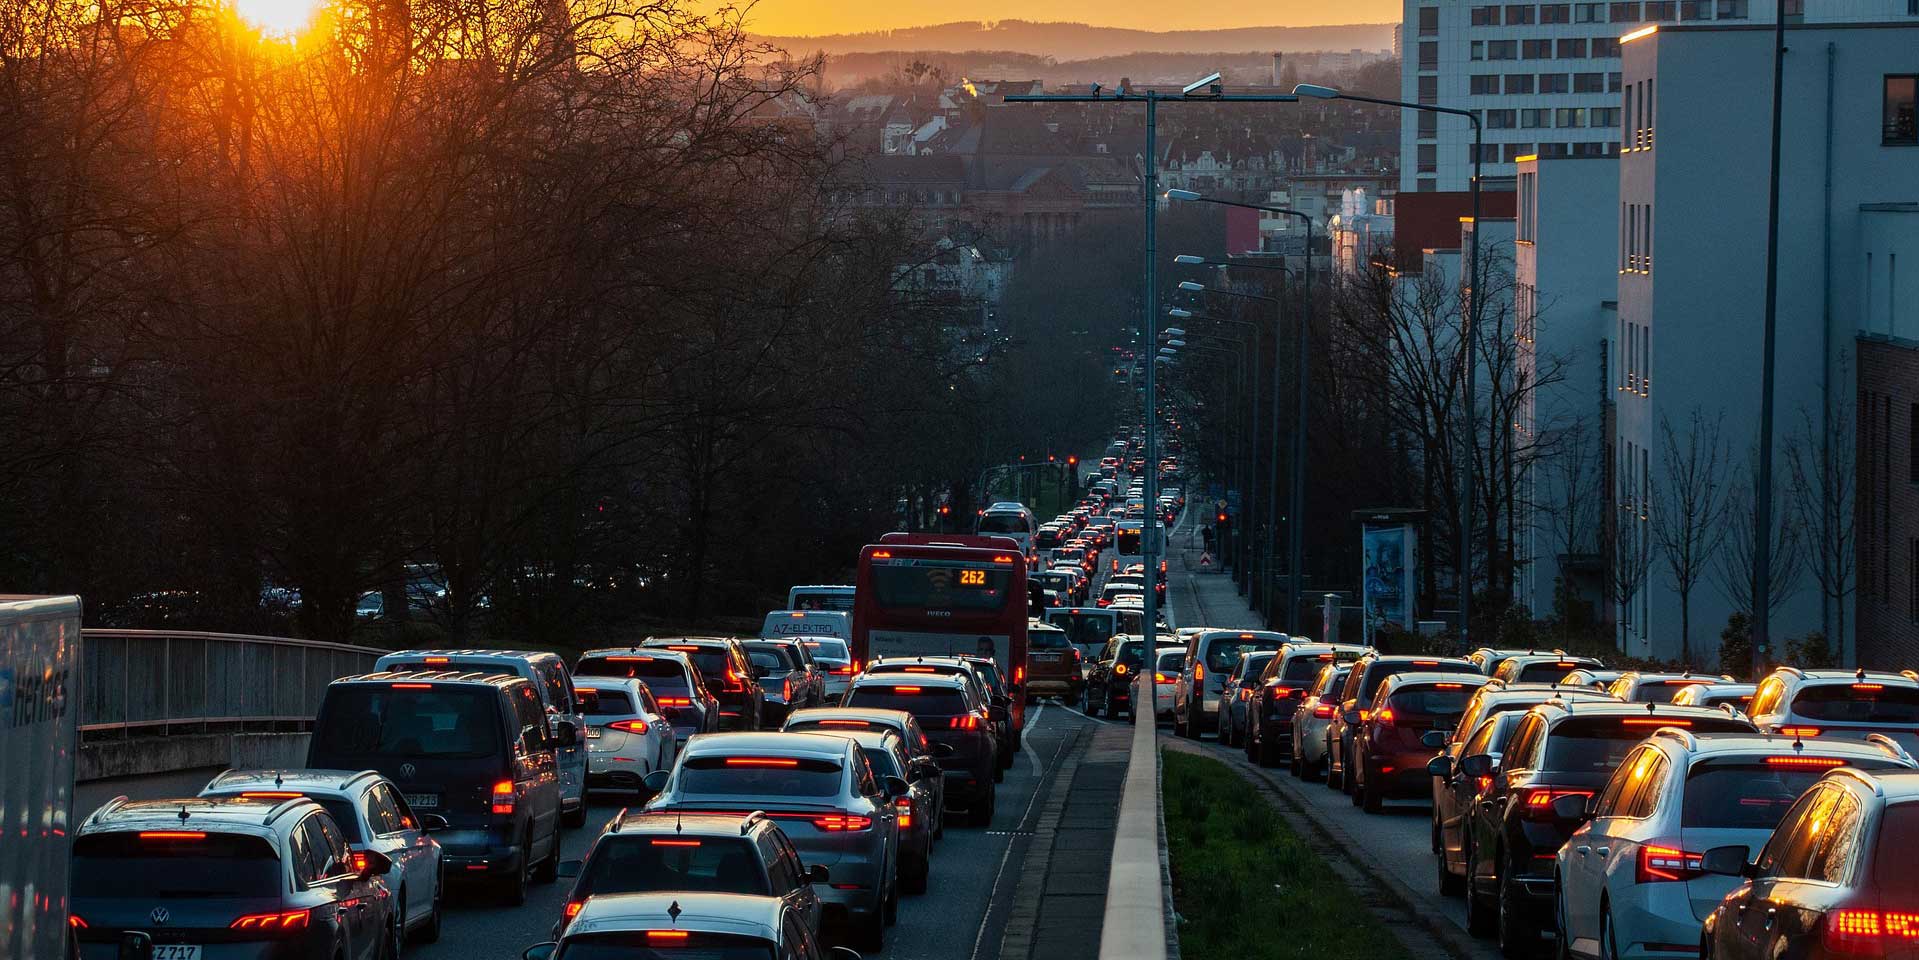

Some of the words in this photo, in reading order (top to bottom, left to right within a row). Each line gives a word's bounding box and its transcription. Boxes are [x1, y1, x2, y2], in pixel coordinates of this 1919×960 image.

[961, 570, 985, 584] 262
[773, 623, 832, 634] AZ-ELEKTRO
[169, 946, 195, 960] 717
